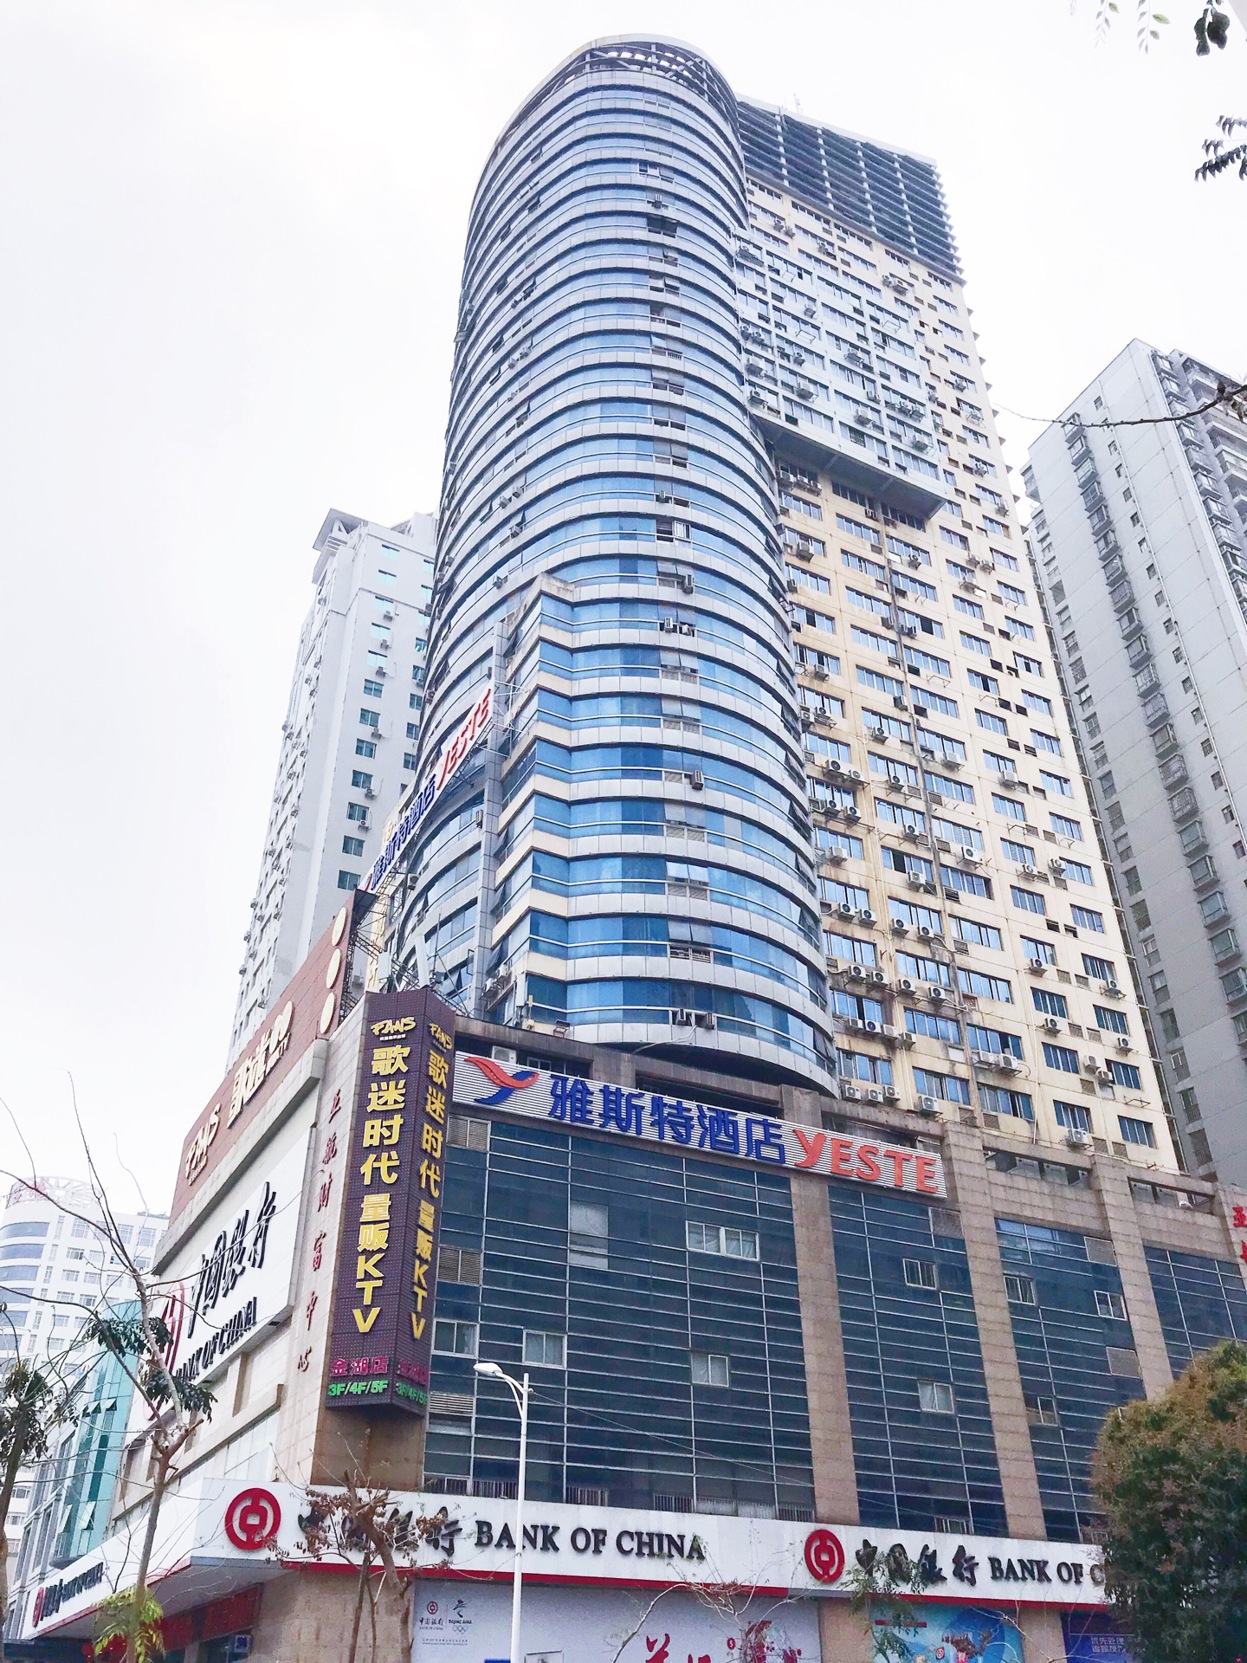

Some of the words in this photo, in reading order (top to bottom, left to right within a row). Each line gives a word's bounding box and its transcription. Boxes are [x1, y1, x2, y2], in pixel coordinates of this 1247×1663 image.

[370, 1017, 417, 1036] FANS
[429, 1023, 453, 1050] FANS
[548, 1073, 786, 1165] 雅斯特酒店
[792, 1128, 939, 1194] YESTE
[187, 1181, 277, 1339] 中国银行
[328, 1380, 388, 1396] 3F/4F/5F
[475, 1520, 561, 1553] BANK
[570, 1527, 608, 1554] OF
[615, 1530, 706, 1560] CHINA
[987, 1555, 1053, 1583] BANK
[1056, 1561, 1084, 1585] OF
